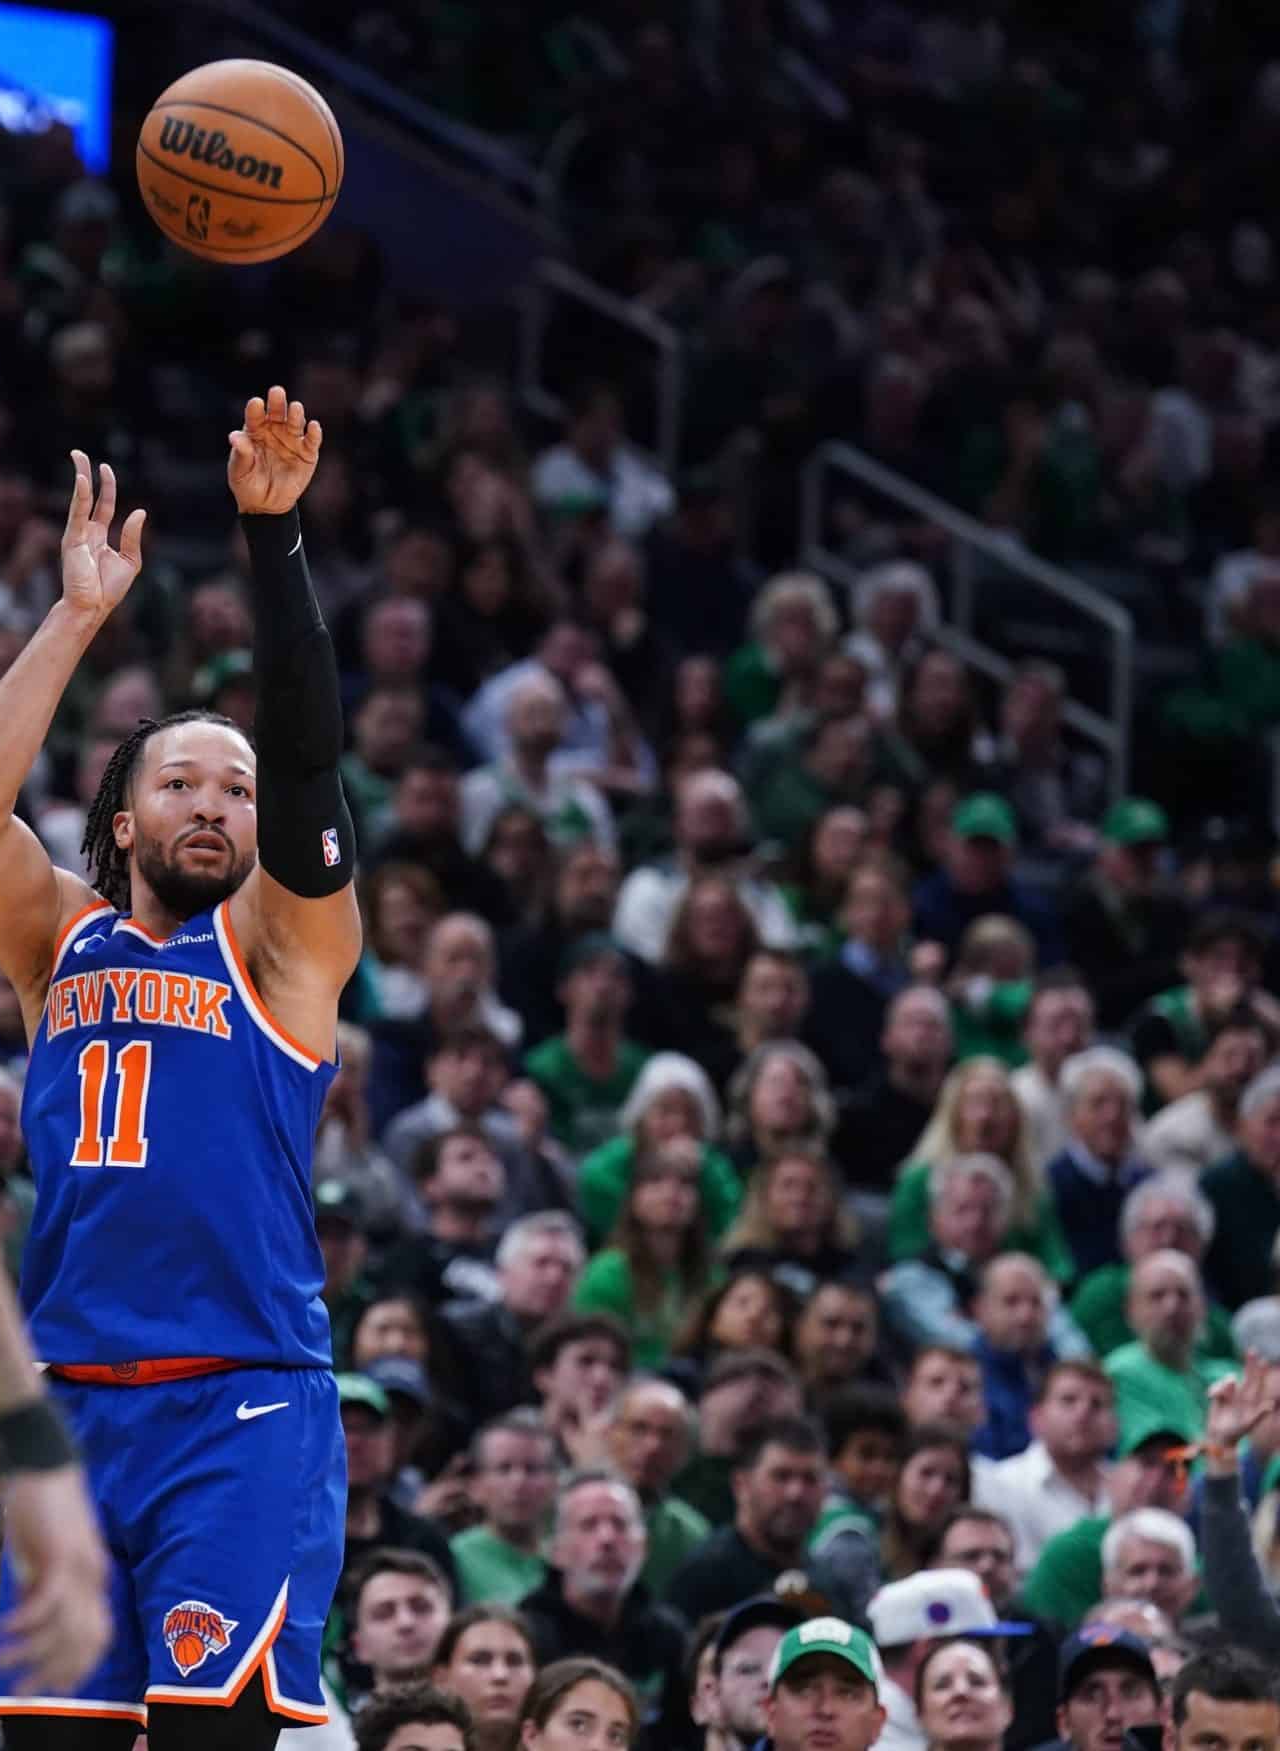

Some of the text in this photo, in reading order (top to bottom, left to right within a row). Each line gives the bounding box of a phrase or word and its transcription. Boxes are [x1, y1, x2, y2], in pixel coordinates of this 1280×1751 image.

[160, 117, 283, 189] Wilson
[69, 1039, 152, 1168] 11
[165, 1608, 228, 1646] KNICKS
